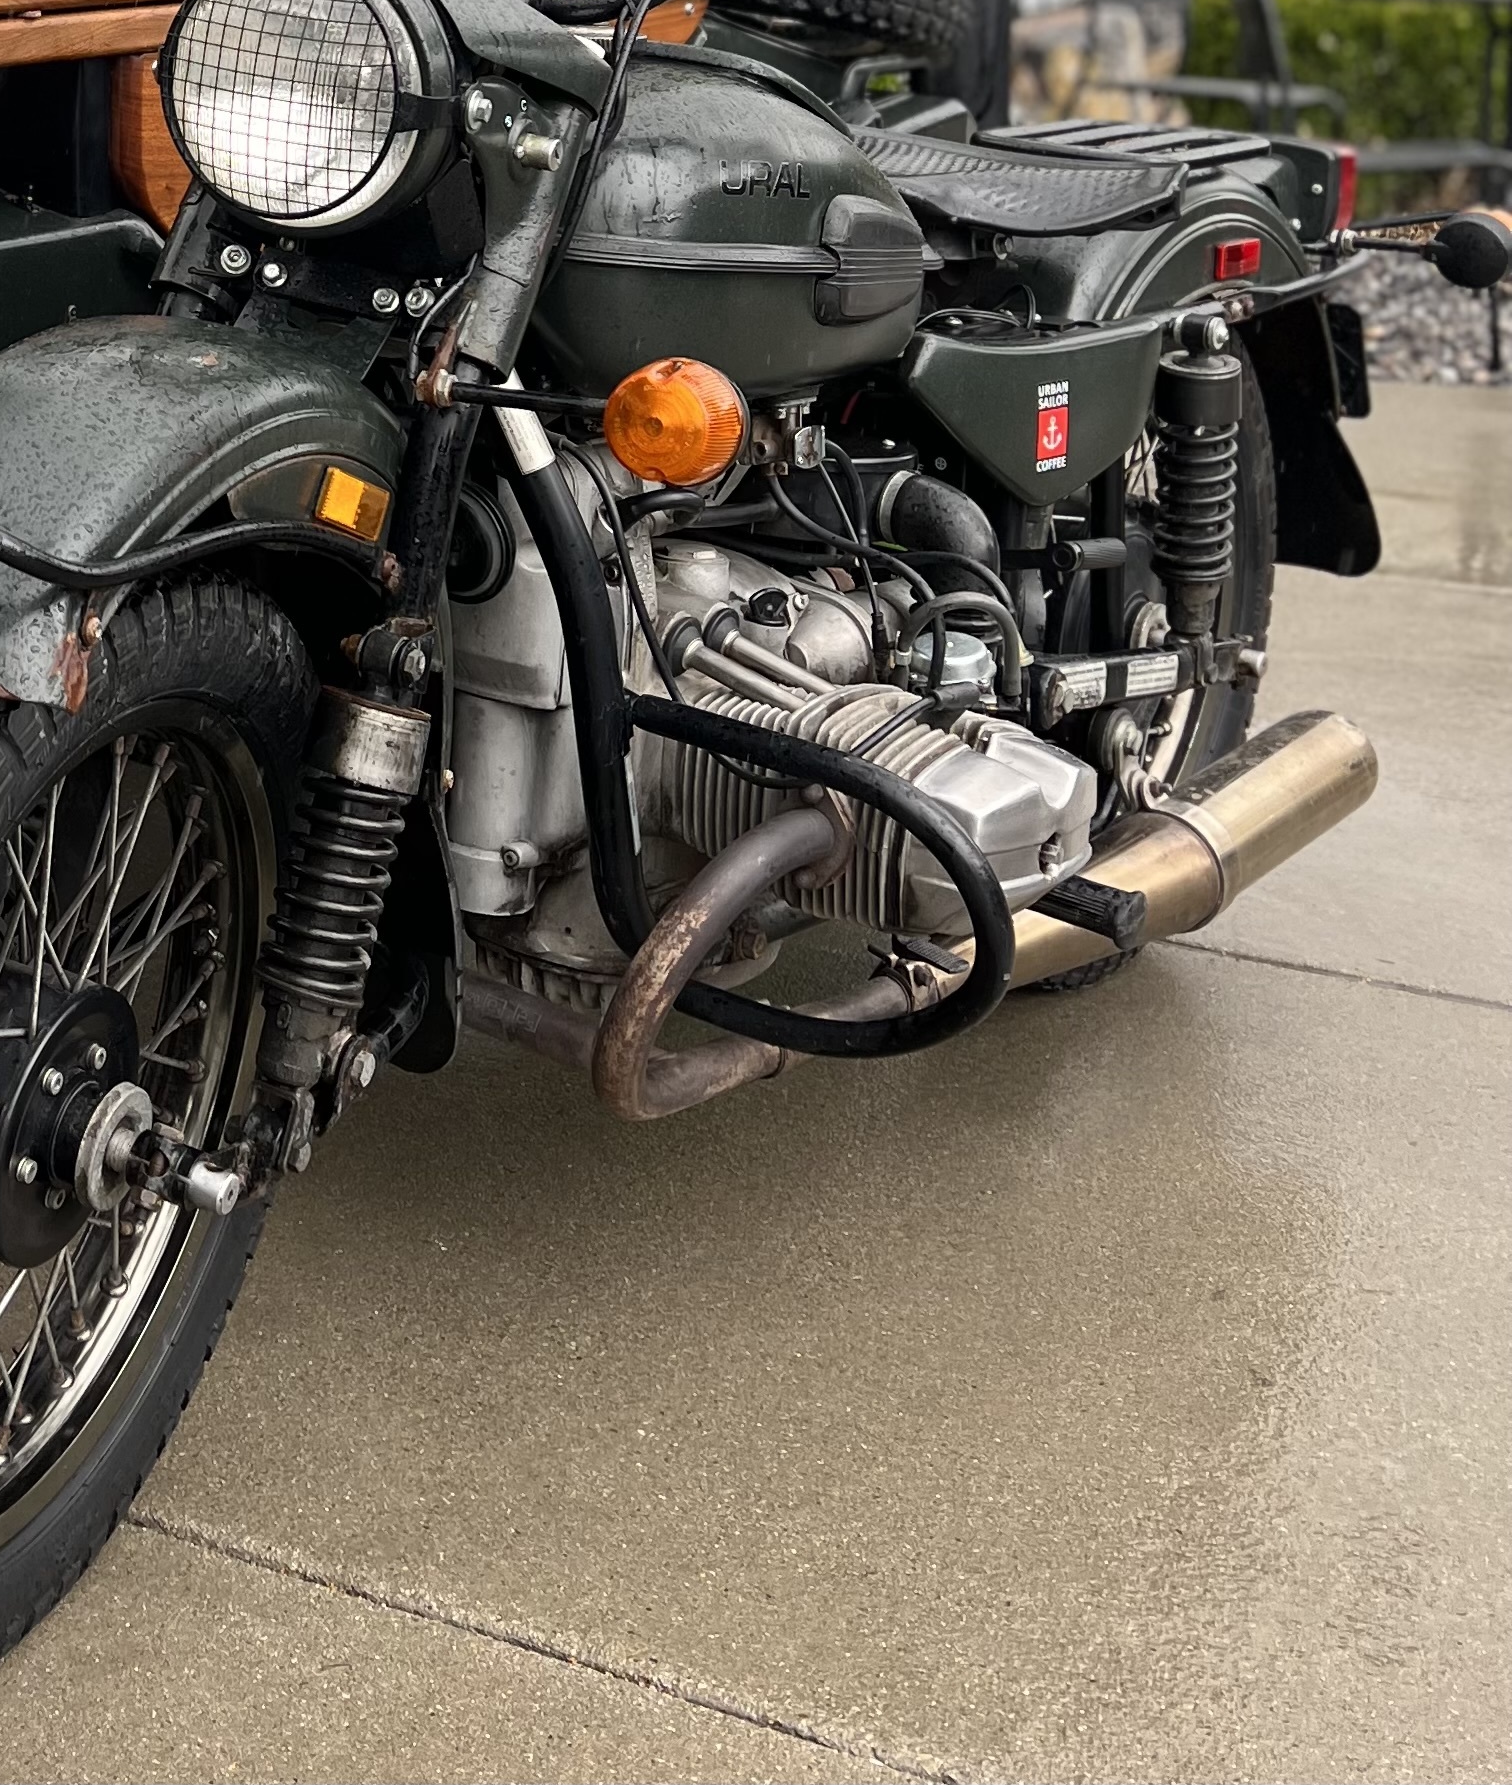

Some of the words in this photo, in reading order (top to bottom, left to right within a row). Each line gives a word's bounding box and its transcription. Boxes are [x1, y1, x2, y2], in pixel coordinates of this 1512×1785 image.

[719, 159, 811, 200] URAL
[1037, 380, 1069, 397] URBAN
[1038, 393, 1069, 410] SAILOR
[1035, 455, 1067, 473] COFFEE
